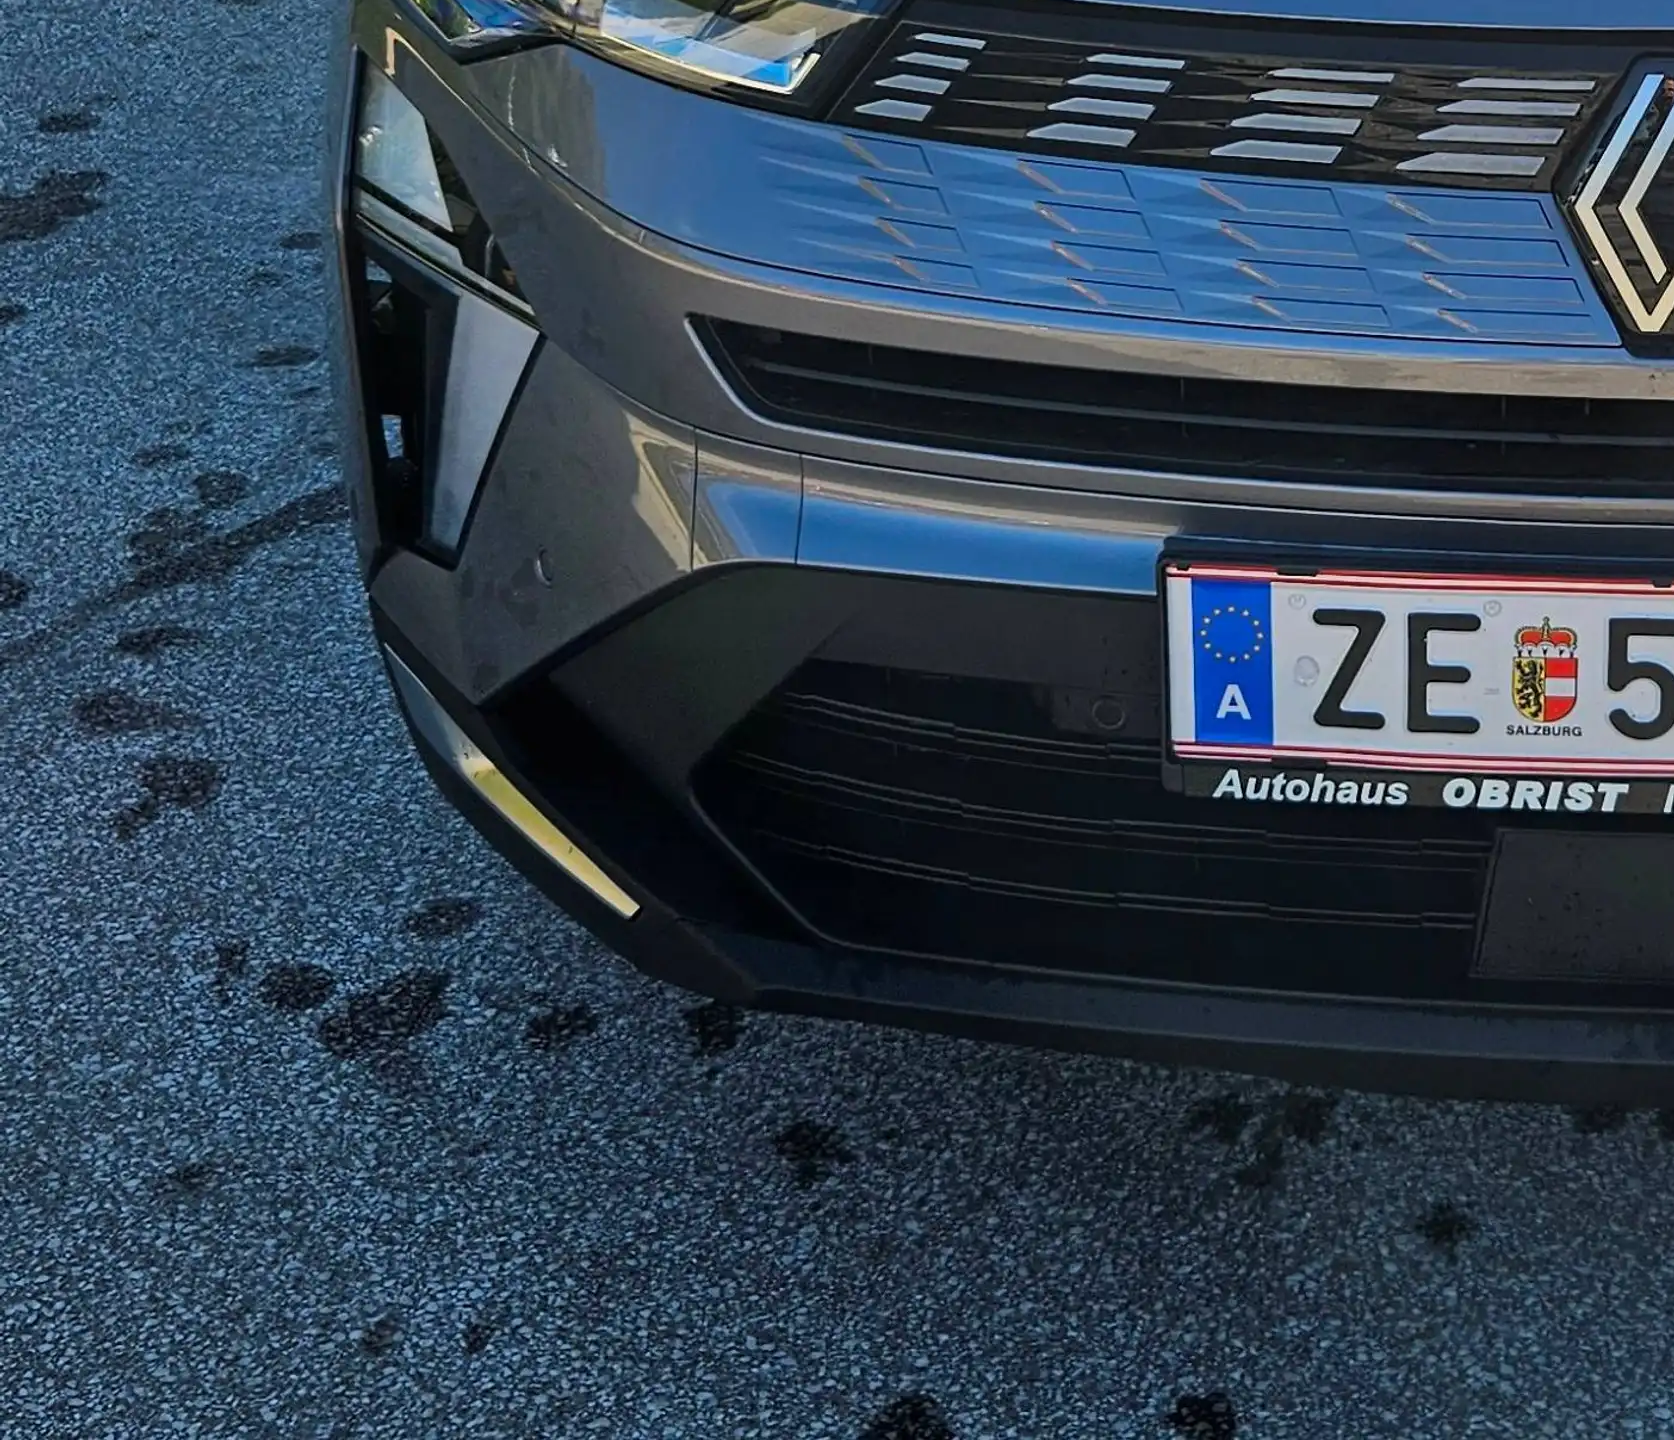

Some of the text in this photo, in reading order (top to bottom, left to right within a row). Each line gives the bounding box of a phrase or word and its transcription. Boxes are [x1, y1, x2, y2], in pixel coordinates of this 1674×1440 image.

[1312, 608, 1482, 734] ZE
[1216, 684, 1251, 720] A
[1506, 724, 1583, 737] SALZBURG
[1212, 768, 1409, 806] Autohaus
[1442, 778, 1631, 813] OBRIST
